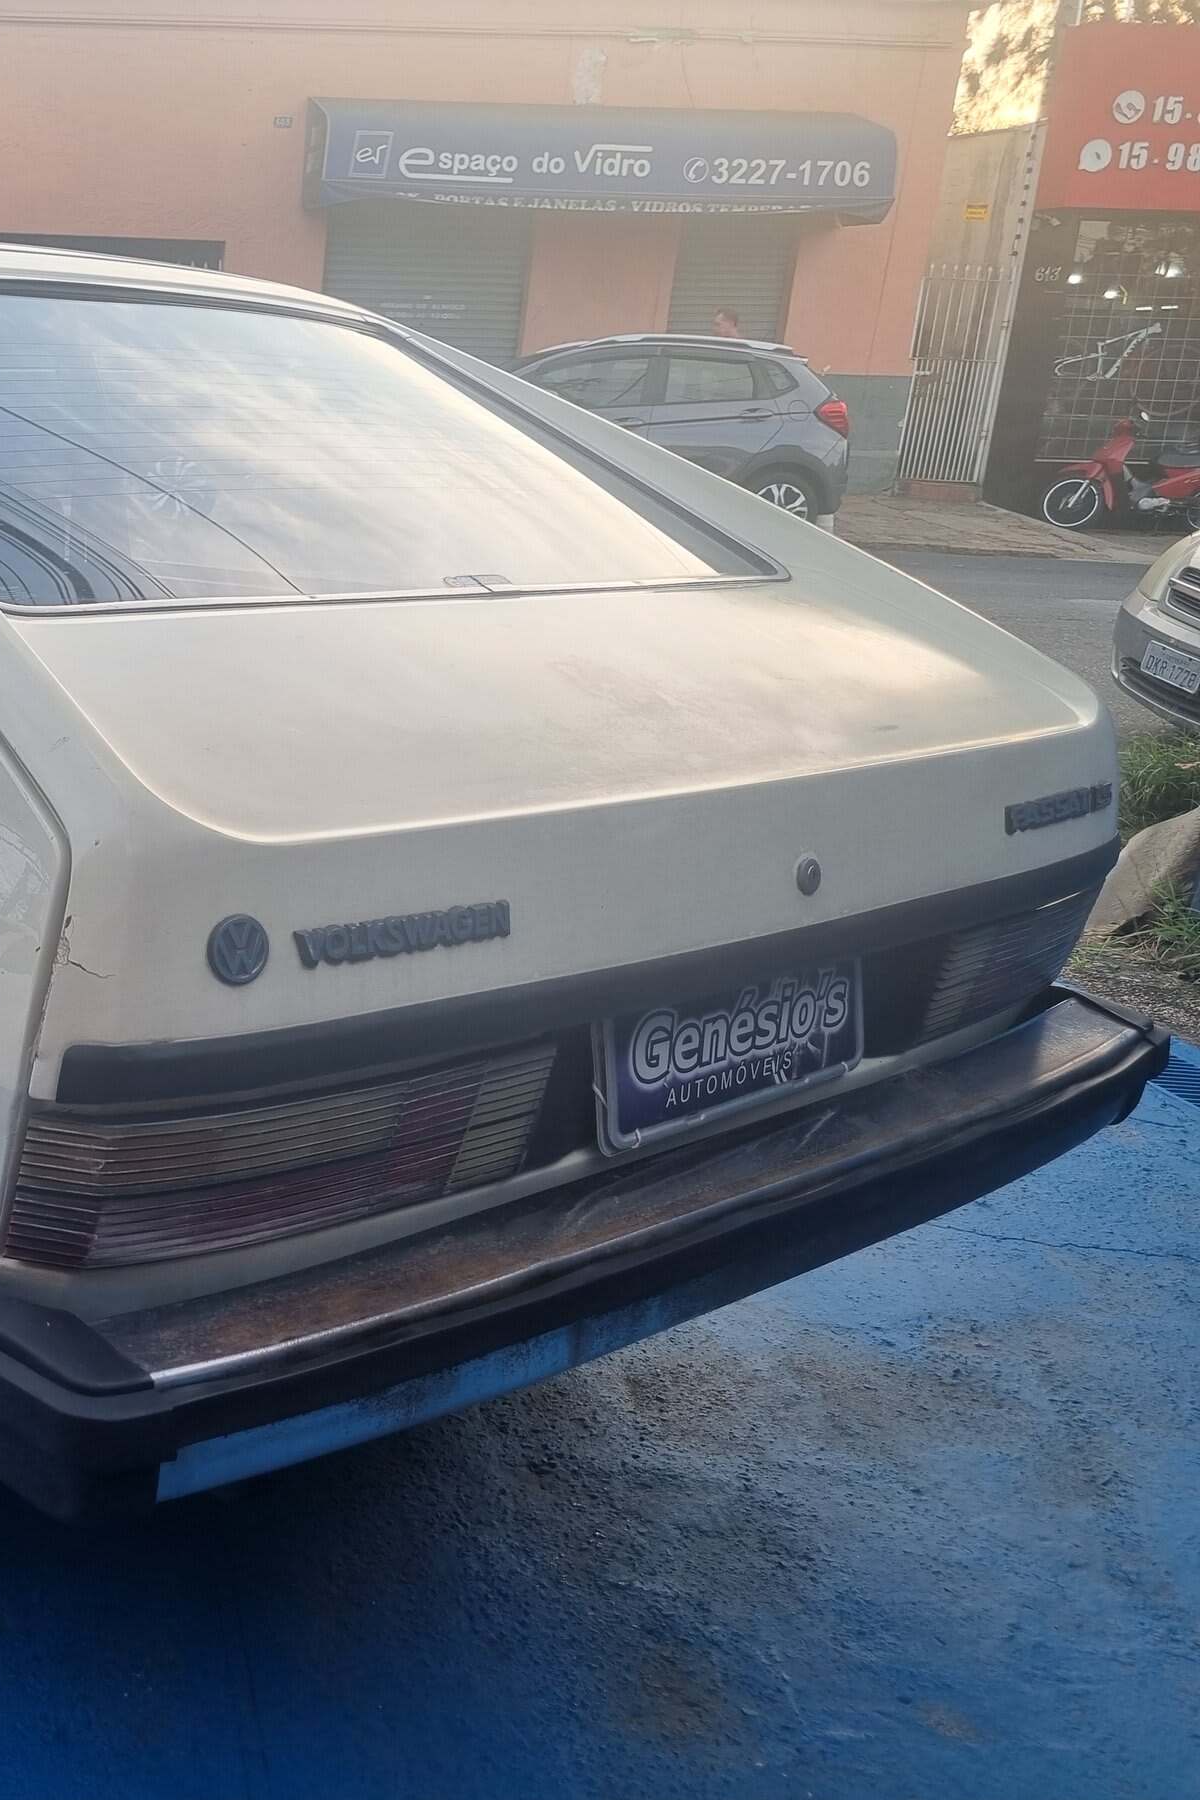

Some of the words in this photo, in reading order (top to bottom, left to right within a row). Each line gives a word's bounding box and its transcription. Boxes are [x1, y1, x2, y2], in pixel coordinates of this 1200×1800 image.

[532, 152, 566, 174] do
[574, 144, 653, 178] Vidro
[711, 157, 872, 188] 3227-1706
[527, 198, 618, 212] JANELAS
[631, 201, 704, 214] VIDROS
[1034, 265, 1062, 282] 613
[293, 899, 511, 970] VOLKSWAGEN
[633, 967, 850, 1084] Genésio's
[664, 1049, 793, 1109] AUTOMÓVEIS
